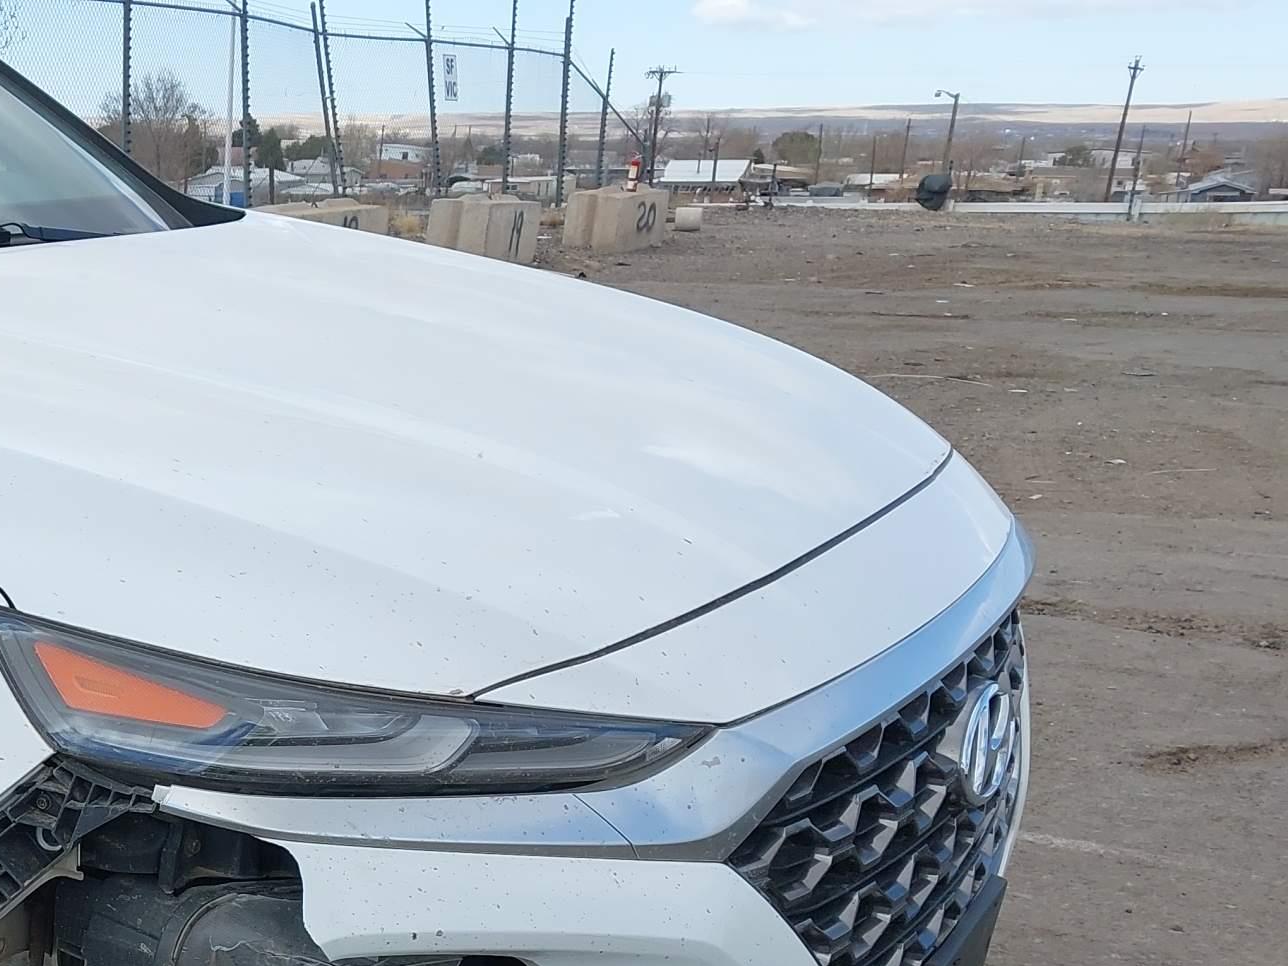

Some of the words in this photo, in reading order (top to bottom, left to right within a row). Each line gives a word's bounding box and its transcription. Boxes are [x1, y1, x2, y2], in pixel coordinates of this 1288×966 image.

[446, 57, 455, 75] SF
[636, 201, 657, 233] 20
[508, 210, 524, 257] 19
